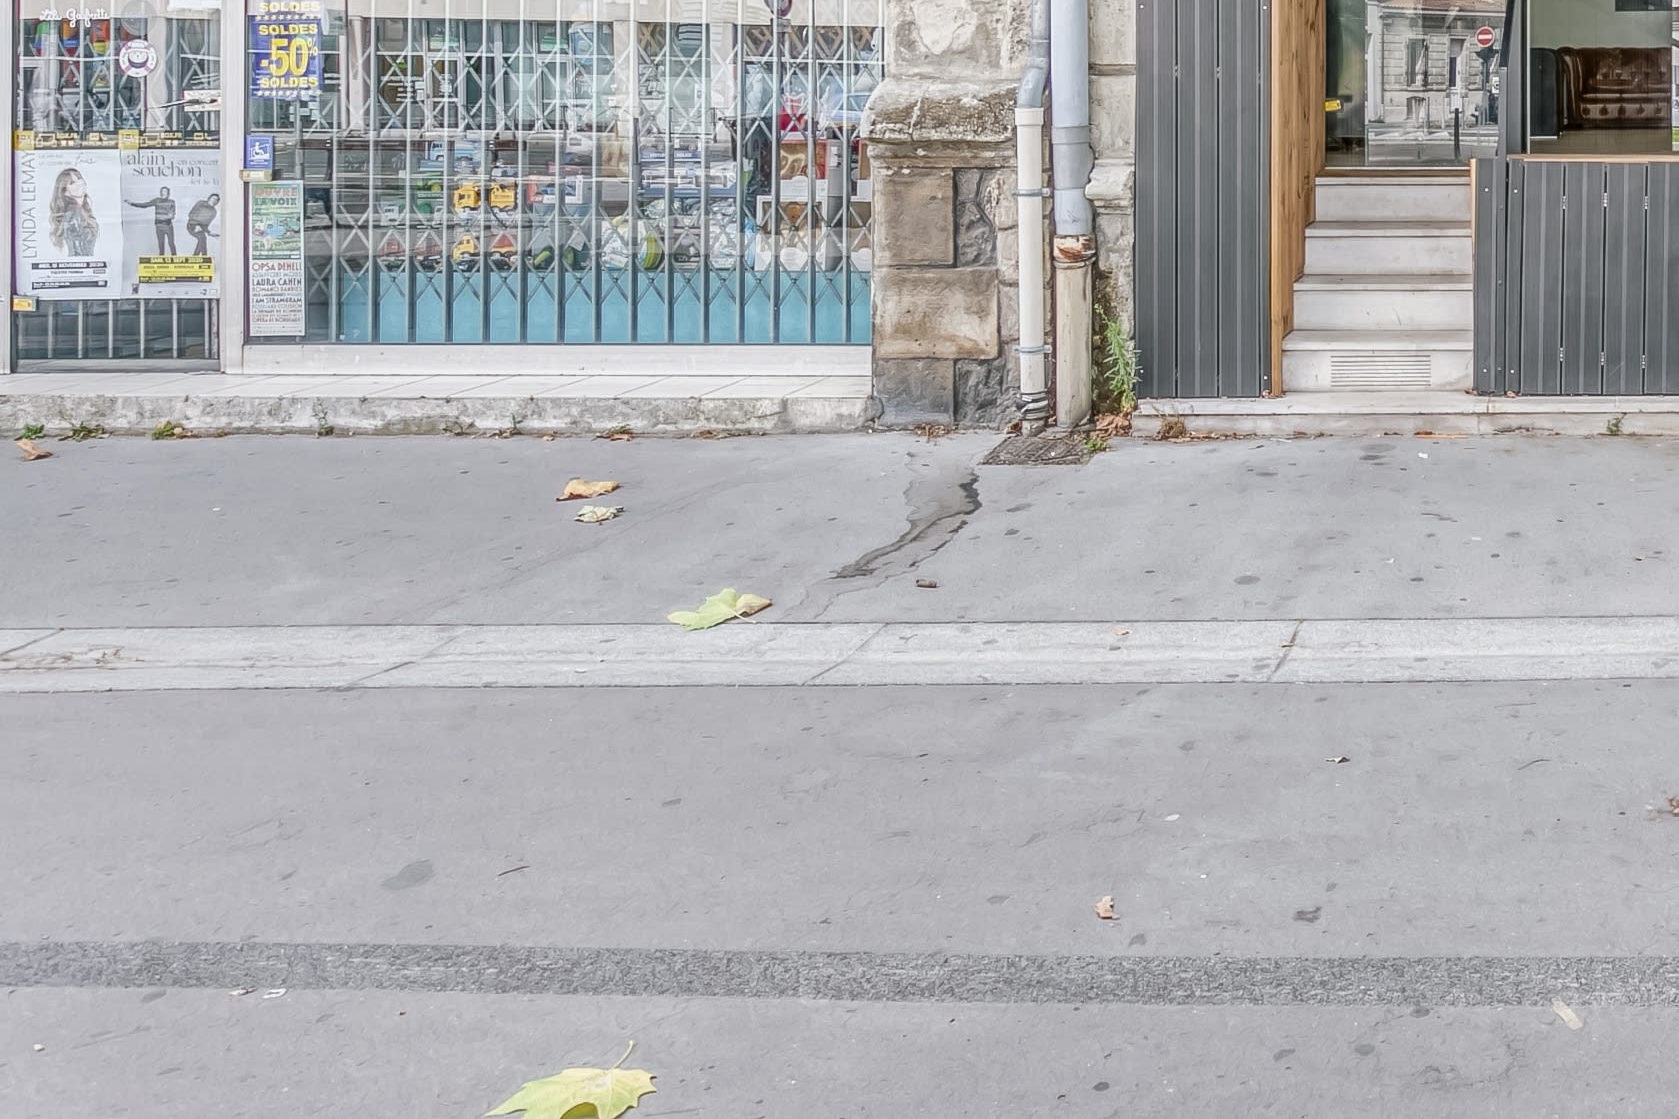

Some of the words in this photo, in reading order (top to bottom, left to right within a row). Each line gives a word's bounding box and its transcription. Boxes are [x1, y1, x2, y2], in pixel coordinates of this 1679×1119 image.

[259, 1, 321, 13] SOLDES
[258, 24, 318, 35] SOLDES
[260, 77, 319, 88] SOLDES
[127, 151, 166, 166] alain
[21, 149, 36, 202] LEMAY
[133, 161, 202, 177] souchon
[22, 207, 37, 259] LYNDA
